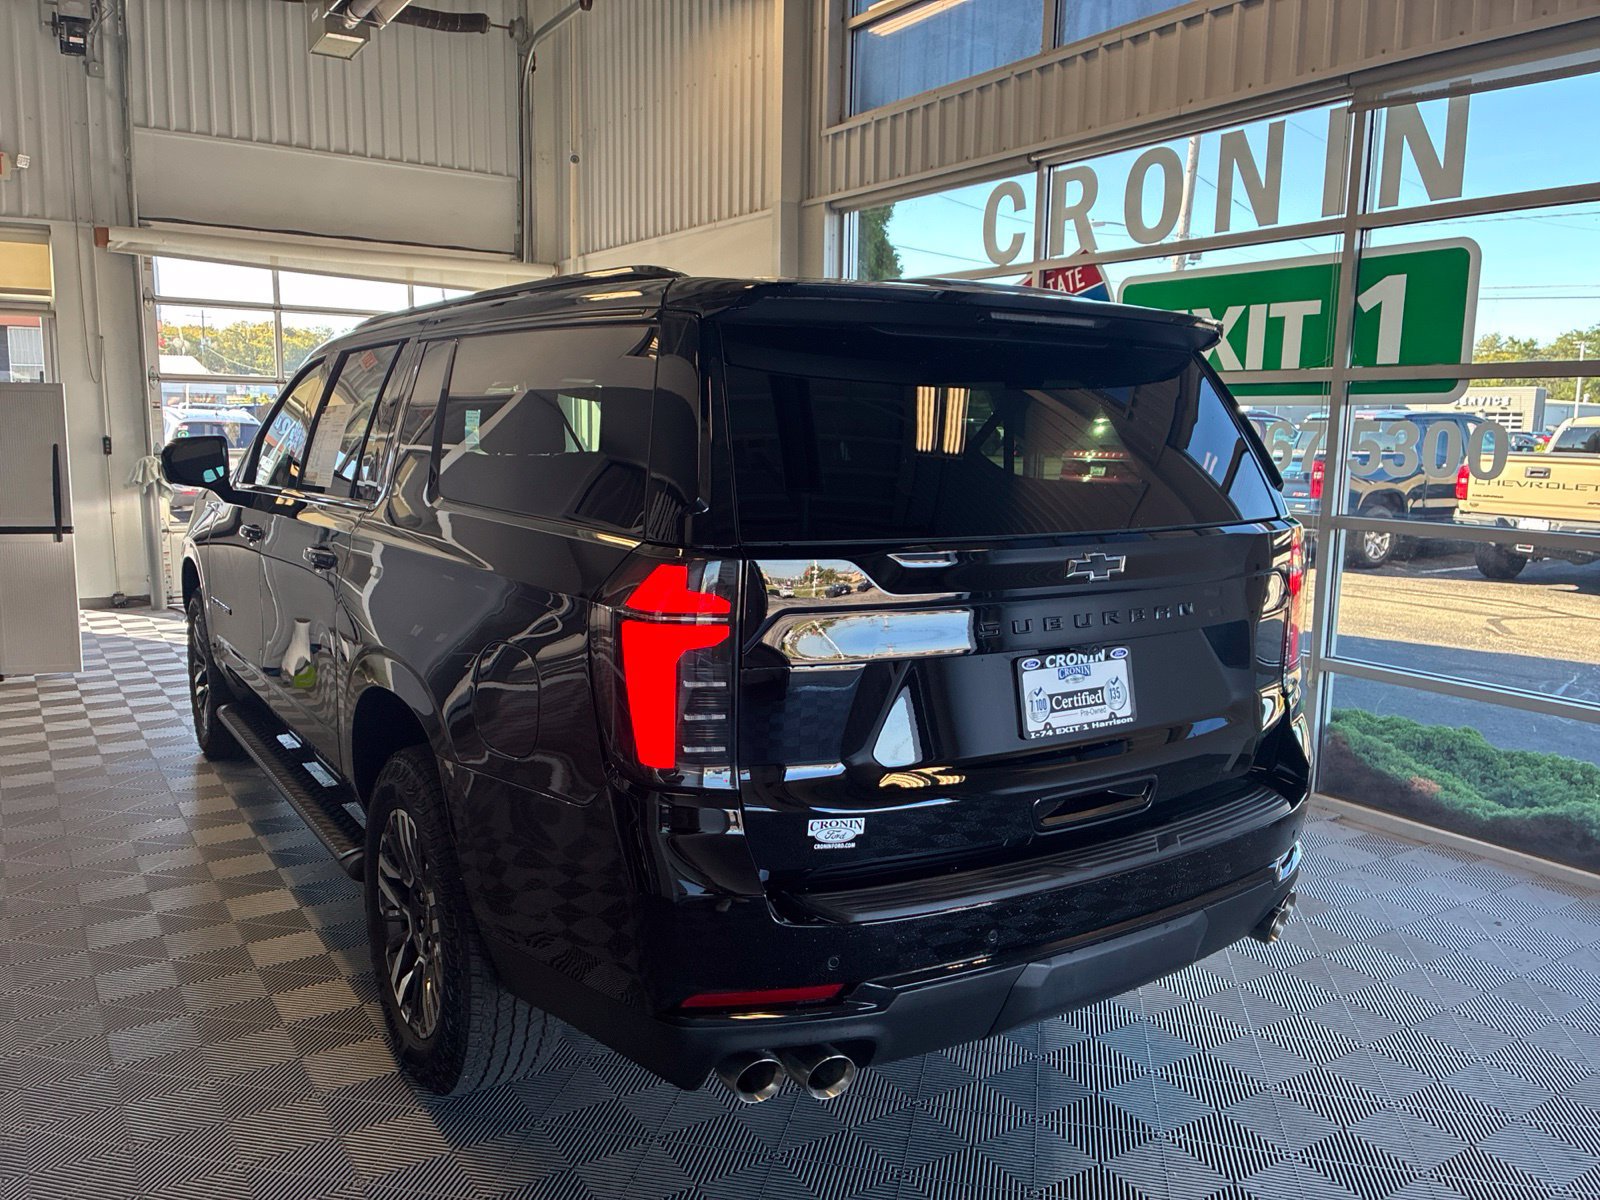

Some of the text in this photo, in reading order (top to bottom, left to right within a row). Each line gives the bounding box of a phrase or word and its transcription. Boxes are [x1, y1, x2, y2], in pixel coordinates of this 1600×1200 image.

[983, 79, 1472, 266] CRONIN
[1046, 266, 1085, 292] TATE
[1174, 273, 1407, 371] XIT 1
[1456, 396, 1512, 407] SERVICE
[978, 601, 1195, 639] SUBURBAN
[1045, 649, 1105, 668] CRONIN
[1058, 665, 1091, 679] CRONIN
[1052, 690, 1103, 709] Certified
[1030, 716, 1133, 739] I-74 EXIT 1 Harrison
[809, 819, 863, 832] CRONIN
[824, 829, 848, 840] Ford
